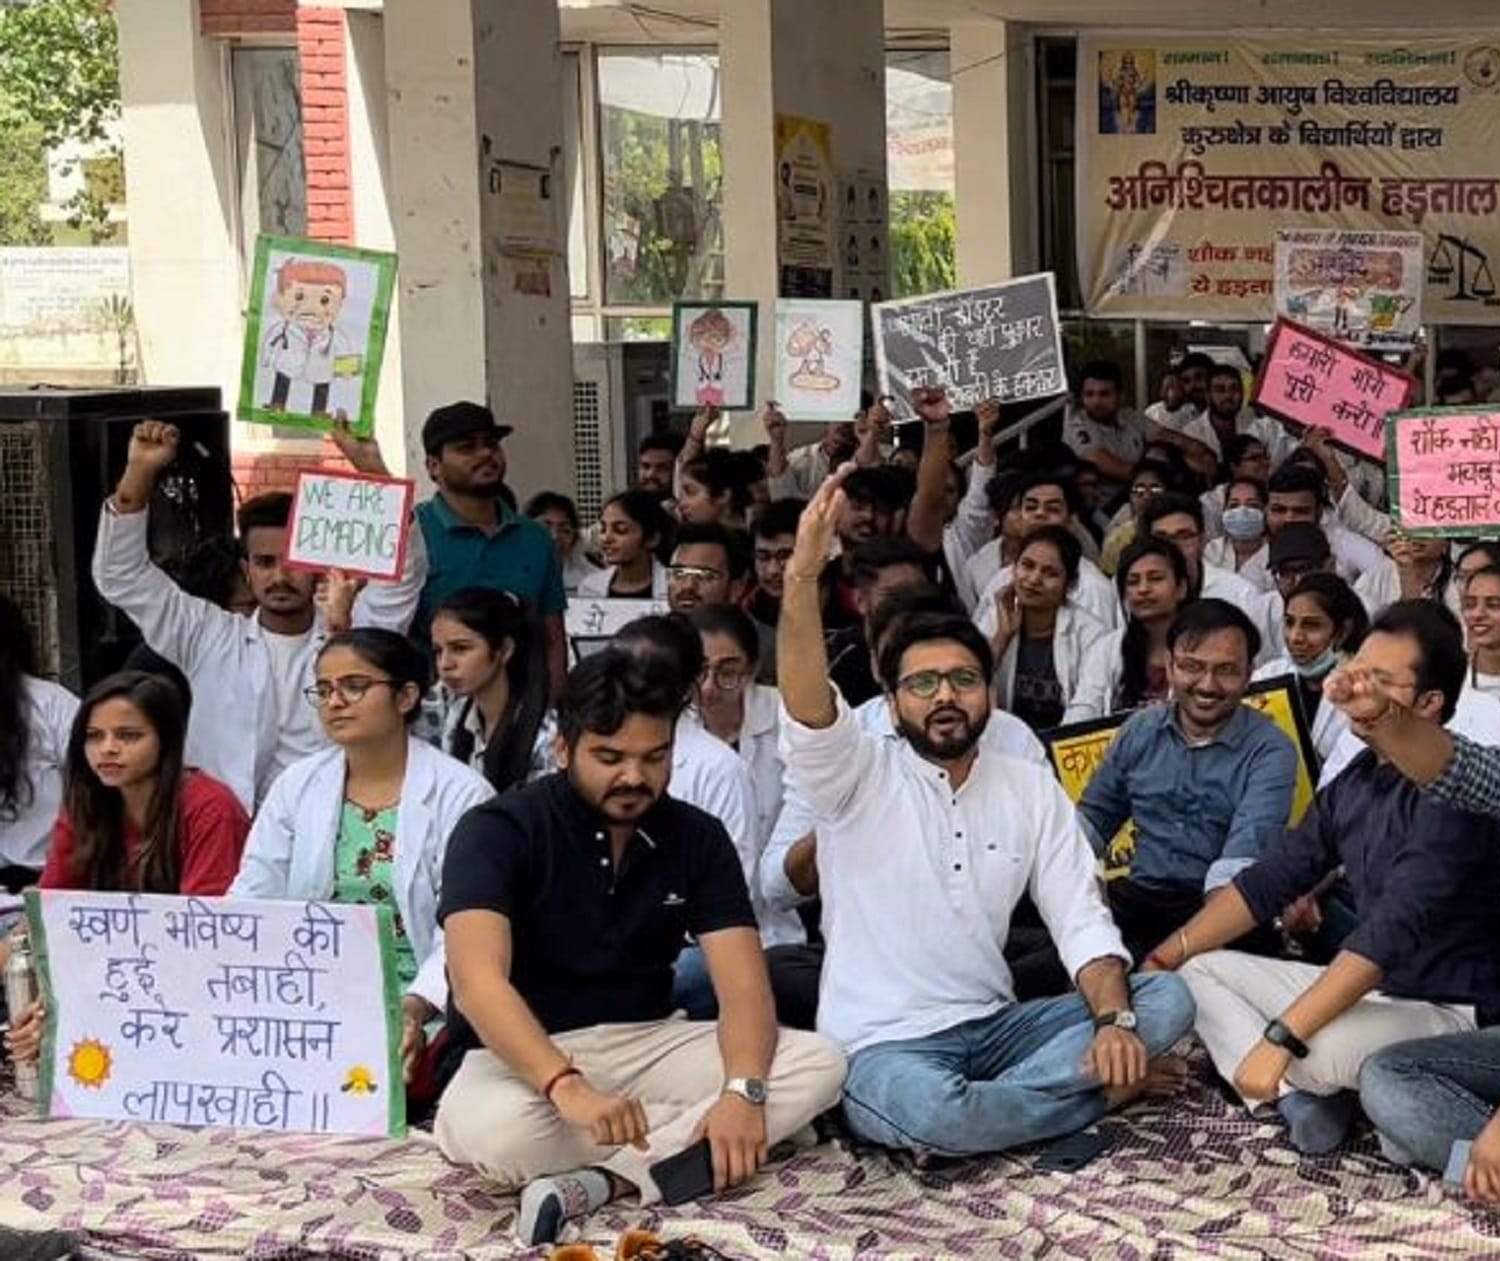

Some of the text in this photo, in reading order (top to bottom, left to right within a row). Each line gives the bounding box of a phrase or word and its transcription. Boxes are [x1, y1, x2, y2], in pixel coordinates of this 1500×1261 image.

[1255, 85, 1316, 116] आयुष
[1323, 78, 1459, 107] विश्वविद्यालय
[1181, 121, 1261, 154] कुरुक्षेत्र
[1268, 120, 1290, 145] के
[1400, 126, 1443, 150] द्वारा
[1105, 160, 1372, 213] अनिश्चितकालीन
[1191, 274, 1211, 293] ये
[303, 481, 385, 514] WE ARE
[164, 898, 262, 952] भविष्य
[293, 902, 345, 958] की
[212, 1012, 342, 1060] प्रशासन
